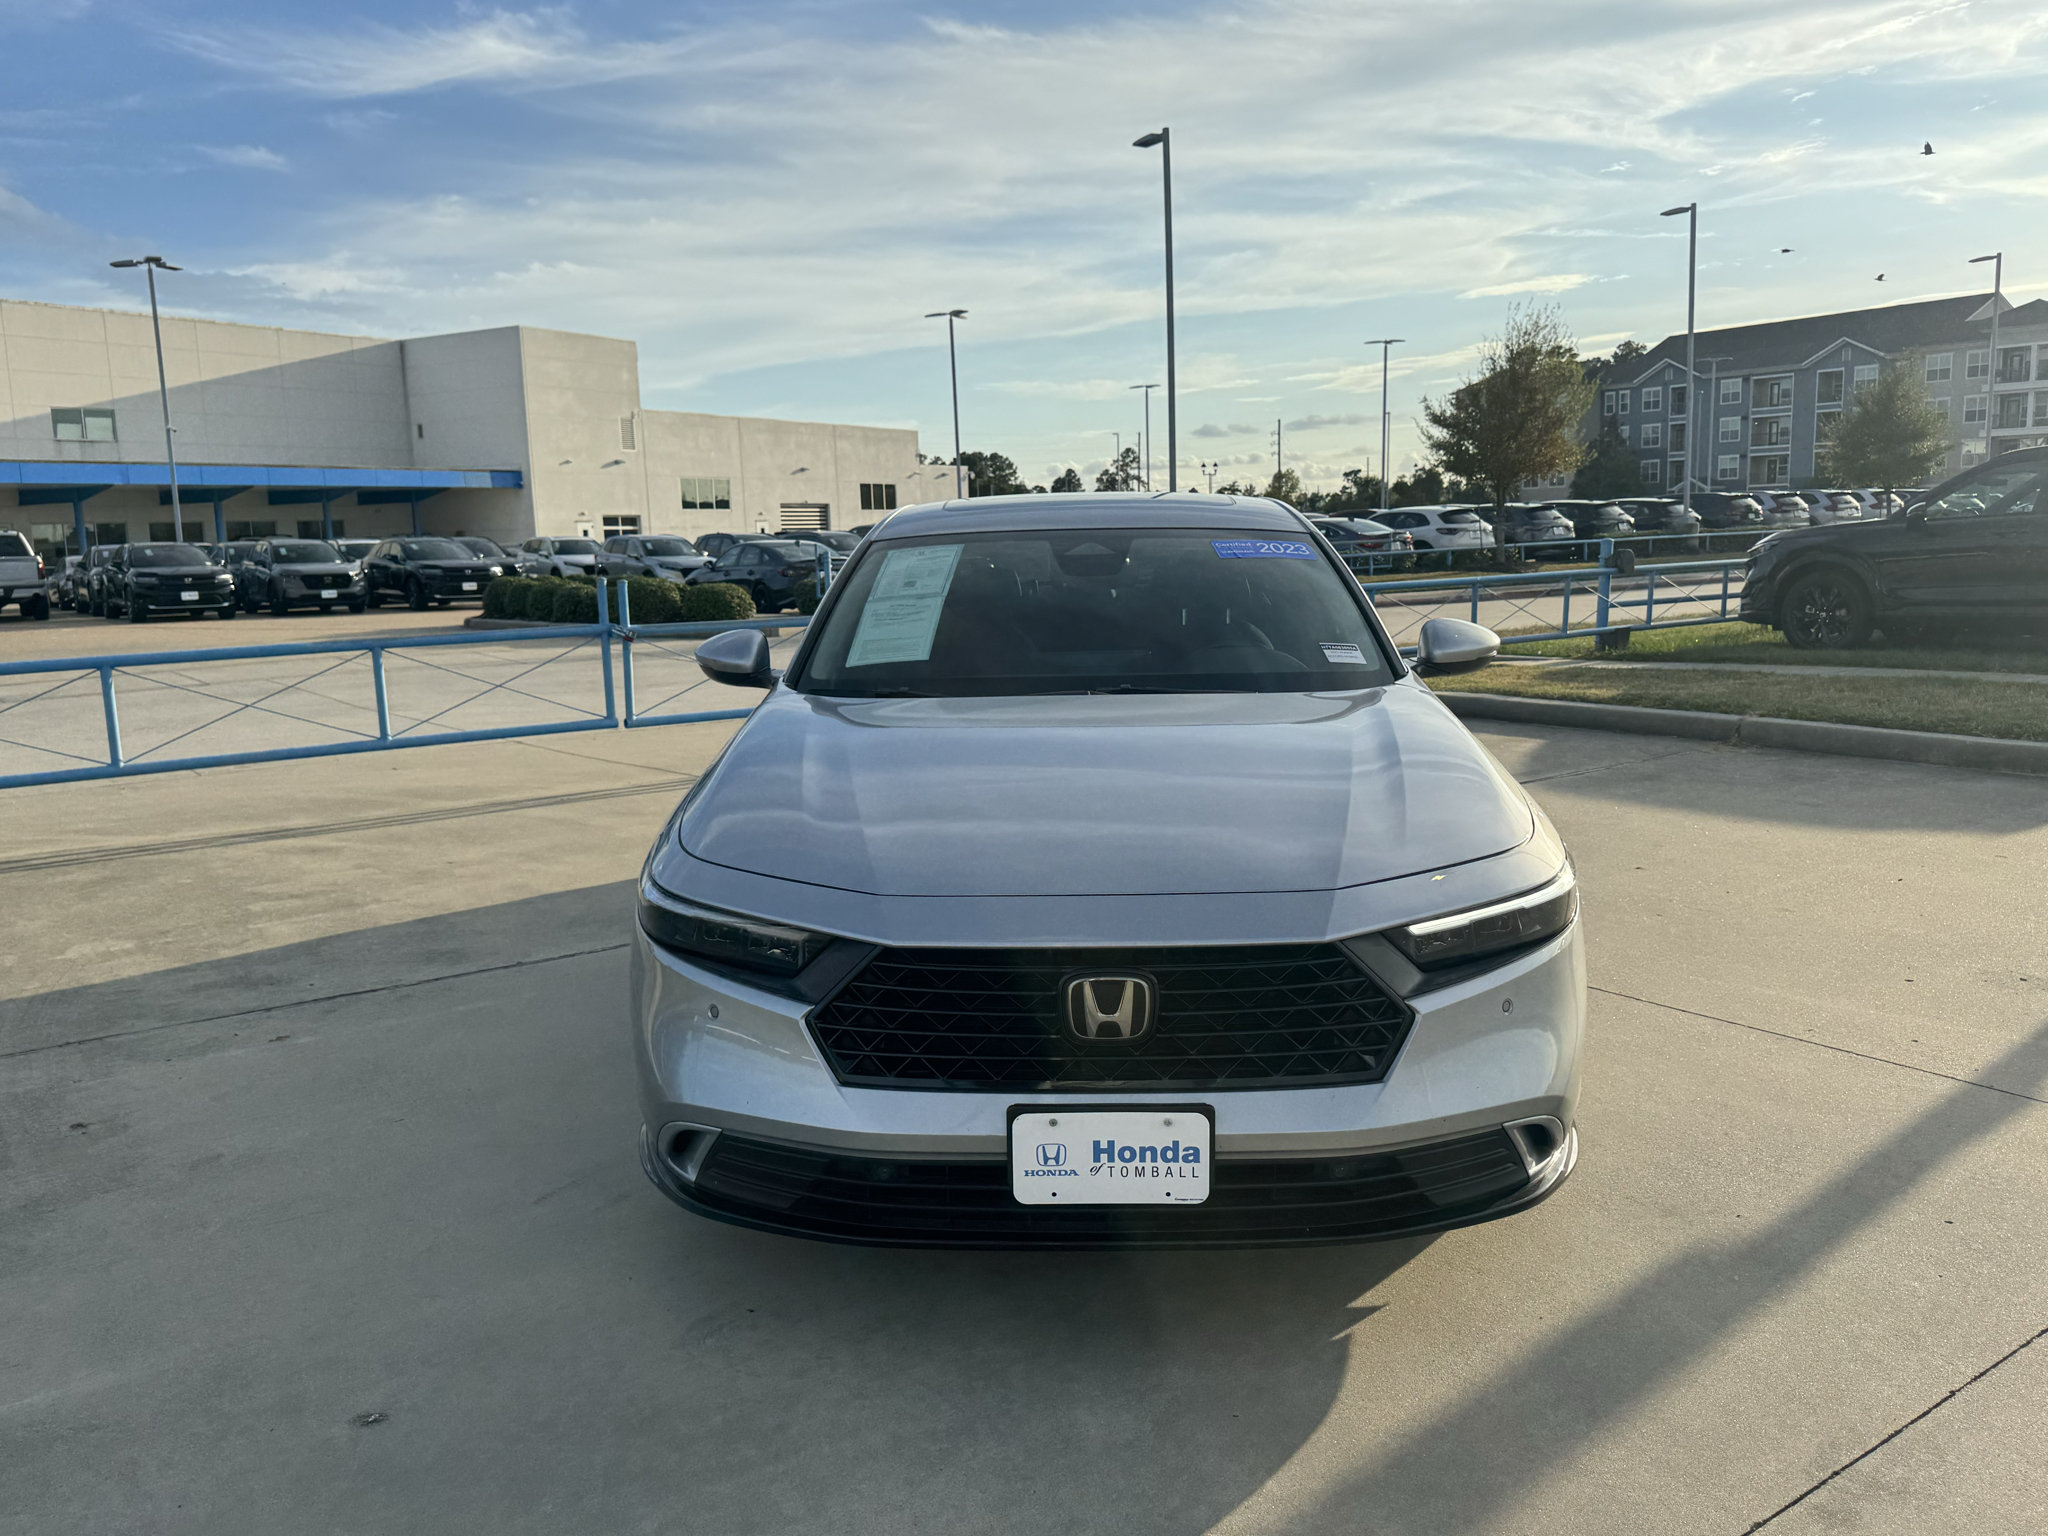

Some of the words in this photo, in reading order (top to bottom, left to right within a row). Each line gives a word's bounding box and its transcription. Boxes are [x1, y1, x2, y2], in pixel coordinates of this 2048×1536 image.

[1256, 542, 1310, 555] 2023
[1092, 1140, 1201, 1164] Honda
[1023, 1169, 1080, 1177] HONDA
[1089, 1162, 1106, 1177] of
[1107, 1165, 1200, 1178] TOMBALL
